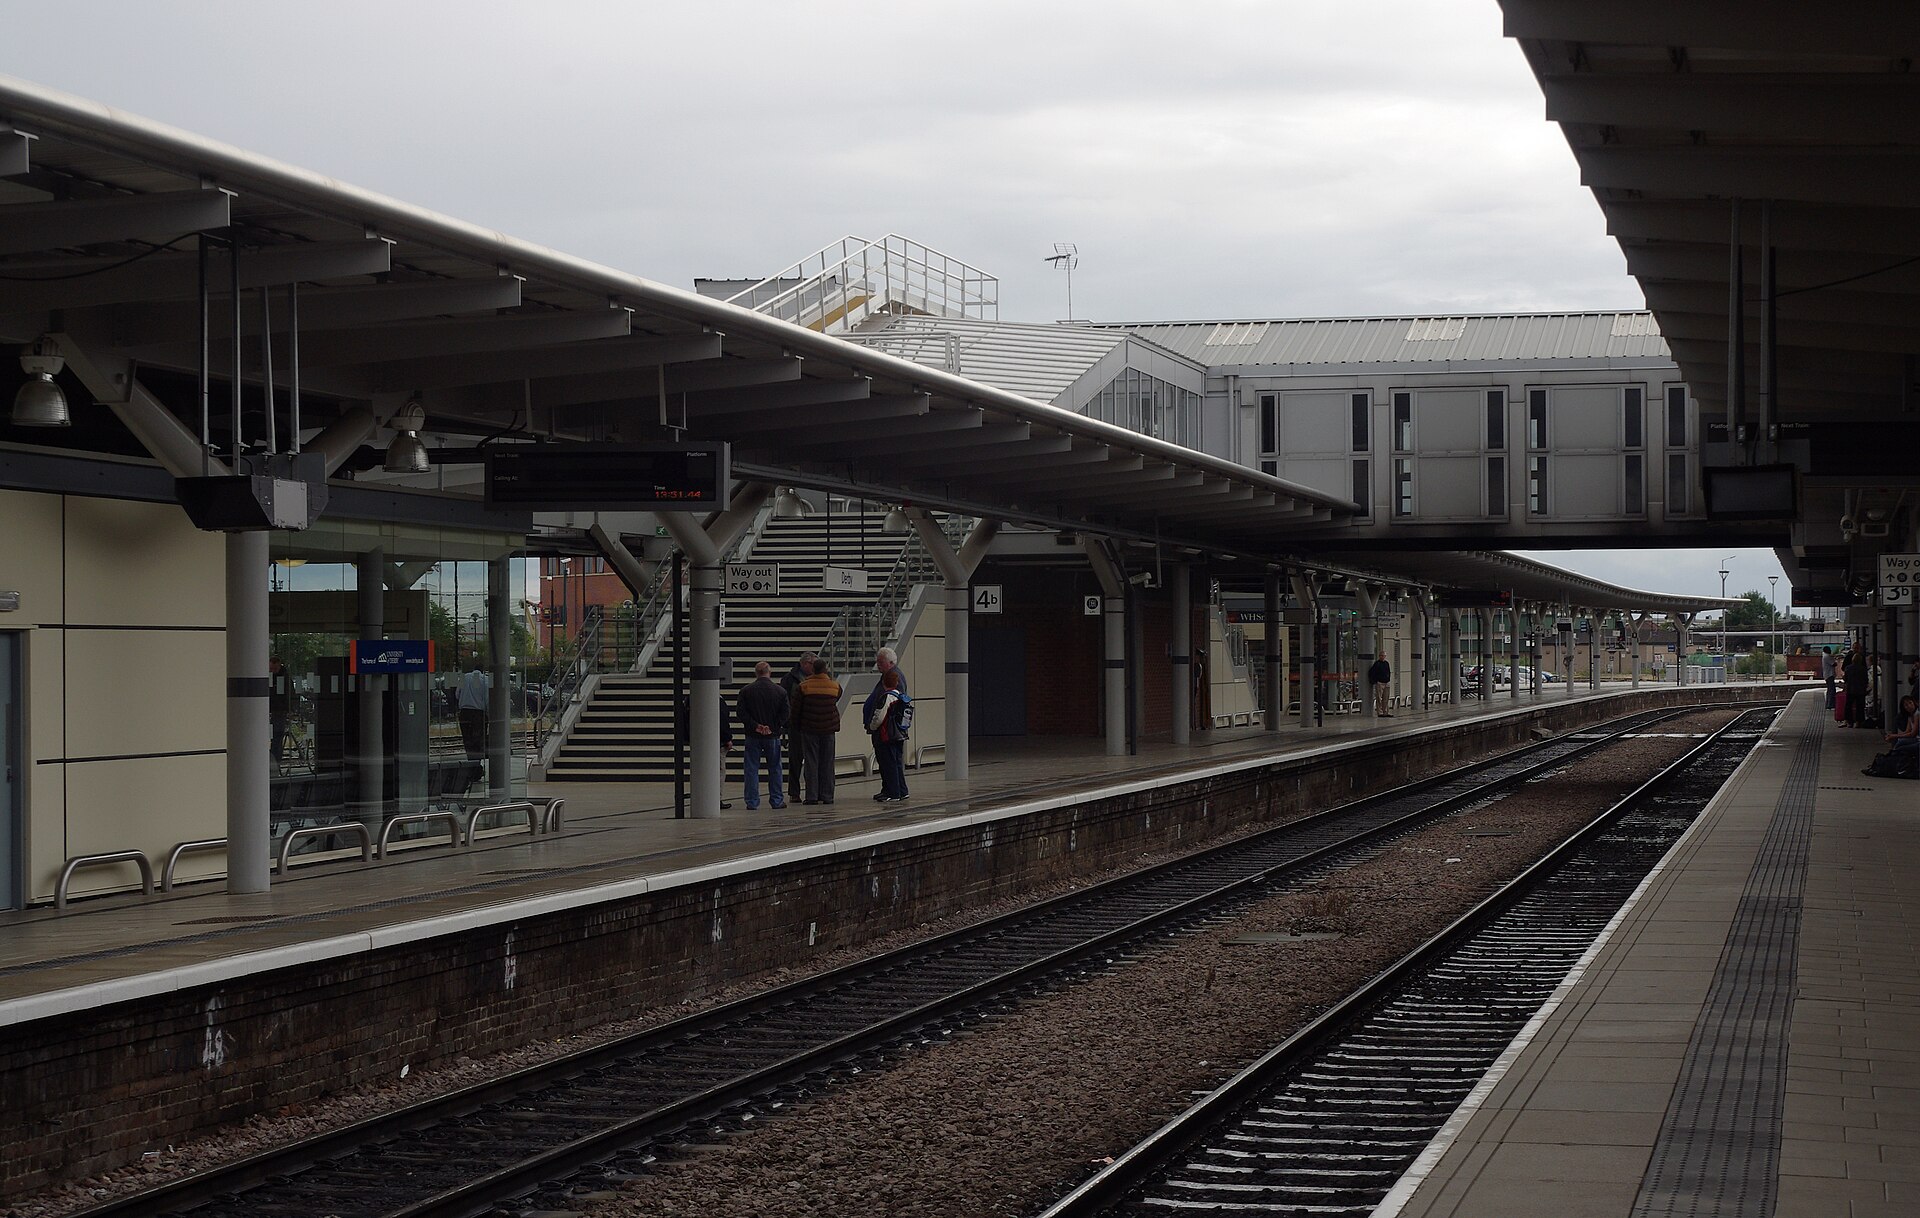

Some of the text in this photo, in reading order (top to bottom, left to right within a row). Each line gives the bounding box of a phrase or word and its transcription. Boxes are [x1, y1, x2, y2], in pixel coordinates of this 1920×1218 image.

[1886, 557, 1911, 570] Way
[731, 567, 772, 578] Way out
[976, 590, 998, 609] 4b
[1886, 587, 1909, 601] 3b
